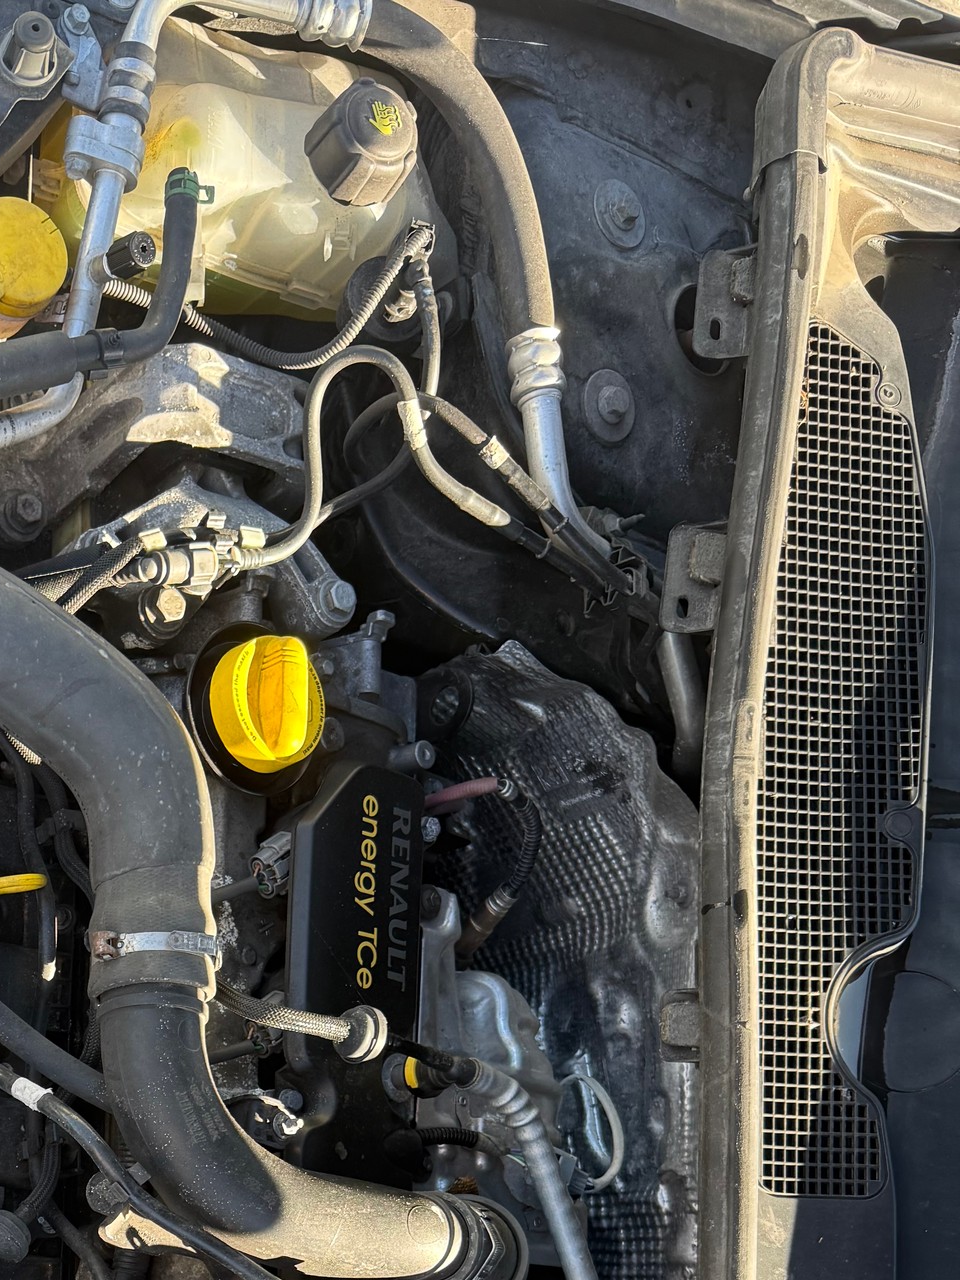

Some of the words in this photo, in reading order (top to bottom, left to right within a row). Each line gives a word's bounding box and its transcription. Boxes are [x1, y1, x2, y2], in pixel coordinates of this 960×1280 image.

[354, 795, 379, 916] energy
[387, 807, 411, 992] RENAULT
[356, 927, 378, 989] TCe
